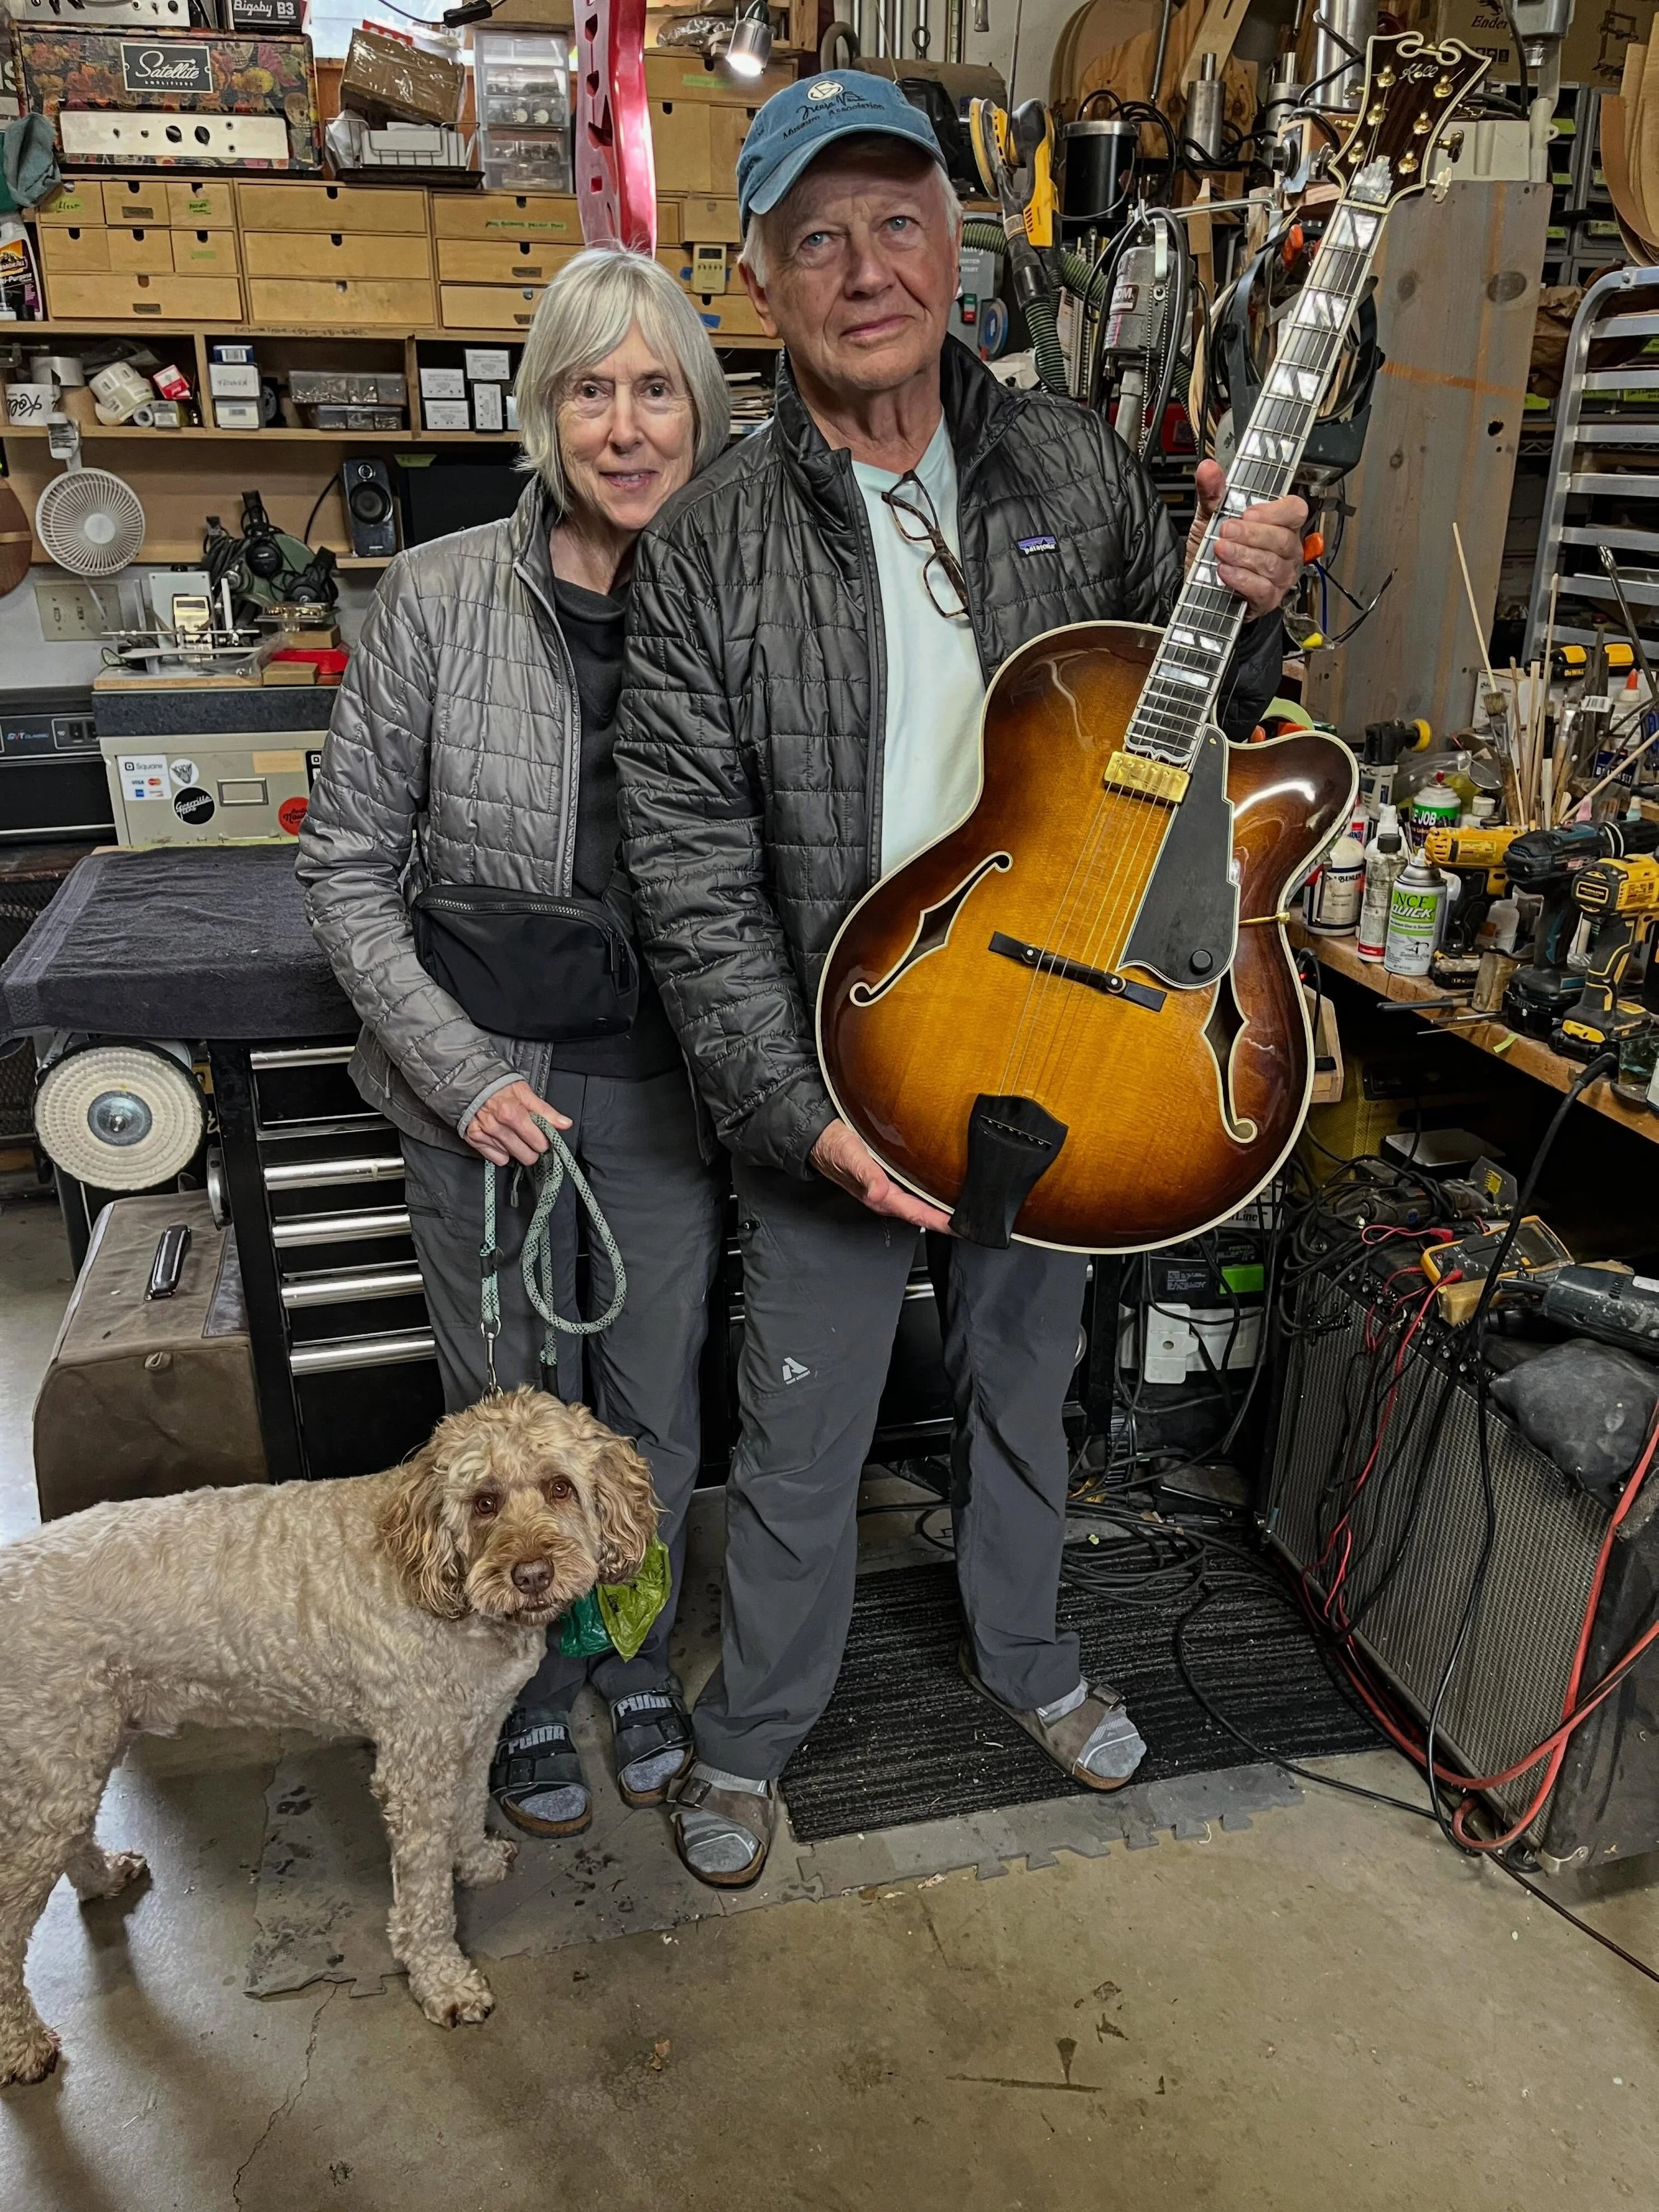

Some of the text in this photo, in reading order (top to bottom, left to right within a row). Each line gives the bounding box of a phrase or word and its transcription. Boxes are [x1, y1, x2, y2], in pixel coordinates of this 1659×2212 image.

[234, 0, 294, 17] Bigsby B3
[135, 50, 200, 79] Satellite
[782, 102, 885, 140] Museum Association
[1417, 810, 1437, 826] JOB
[1396, 891, 1429, 908] NCF
[1392, 904, 1433, 918] QUICK
